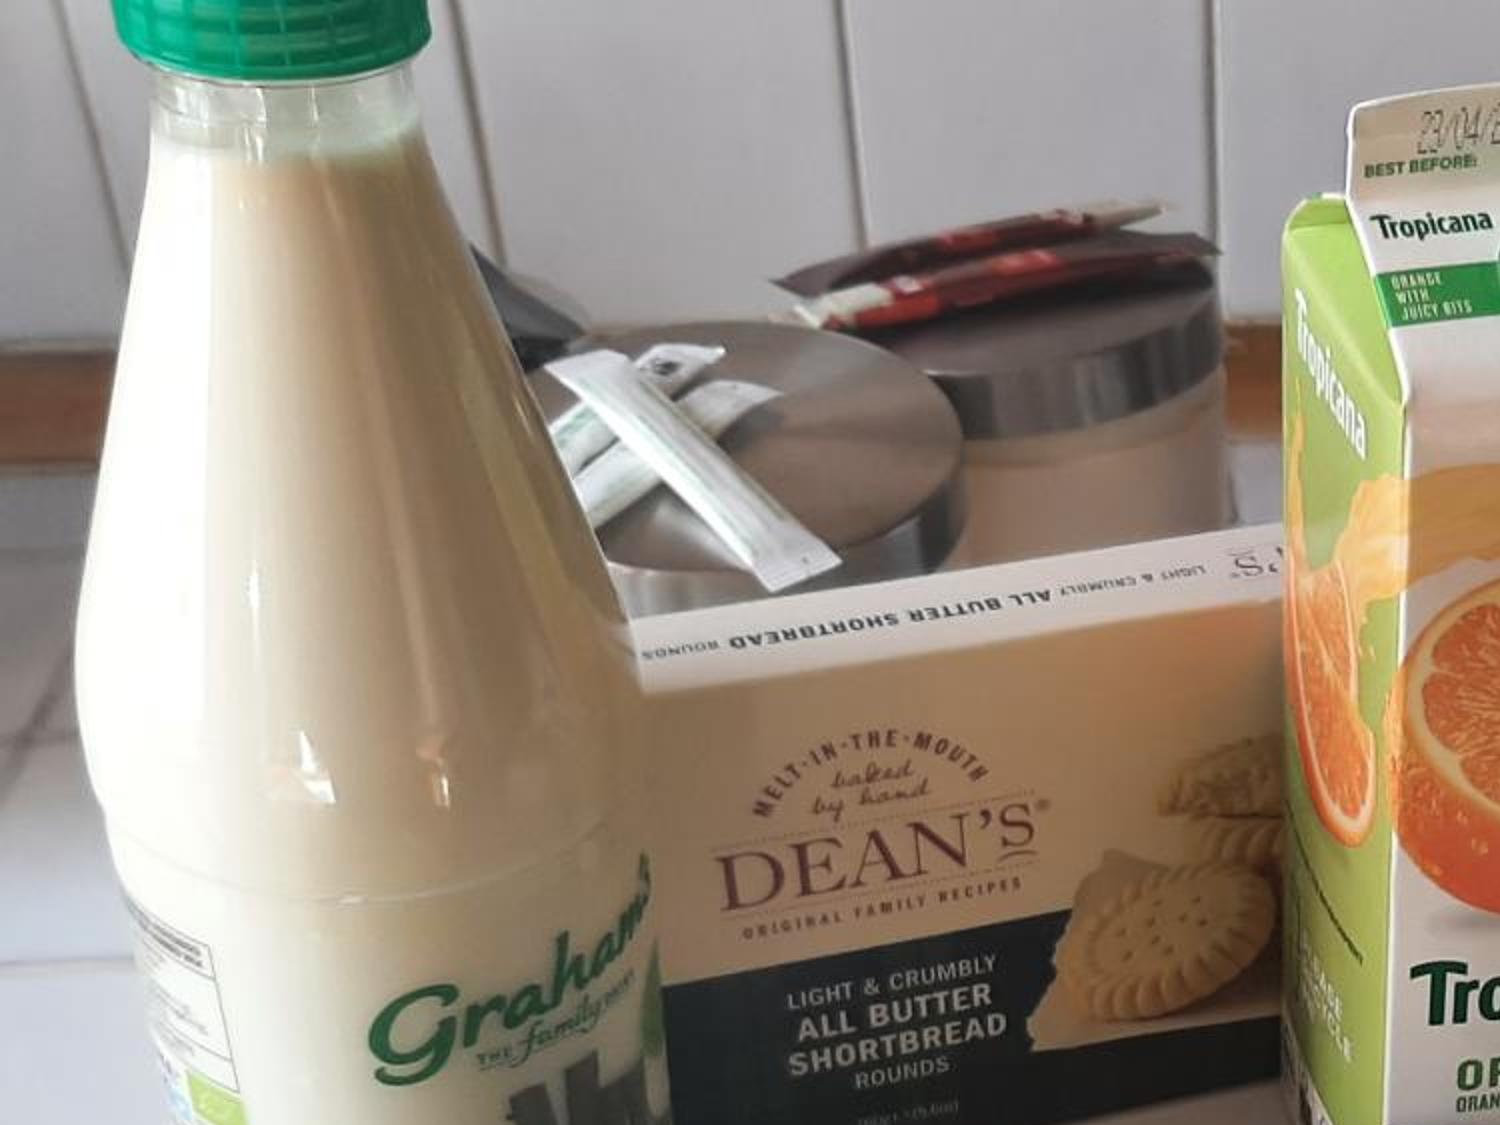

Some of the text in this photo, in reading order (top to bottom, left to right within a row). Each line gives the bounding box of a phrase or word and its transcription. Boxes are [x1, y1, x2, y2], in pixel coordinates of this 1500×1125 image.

[1364, 154, 1478, 178] BEST BEFORE:
[1369, 211, 1494, 241] Tropicana
[1390, 271, 1442, 289] ORANGE
[1396, 288, 1430, 304] WITH
[1401, 299, 1473, 320] JUICY BITS
[1295, 287, 1366, 461] Tropicana
[641, 563, 1208, 662] LIGHT & CRUMBLY ALL BUTTER SHORTBREAD ROUNDS
[811, 798, 845, 827] by
[713, 802, 1037, 912] DEAN'S
[741, 876, 1022, 940] ORIGINAL FAMILY RECIPES
[787, 953, 997, 1010] LIGHT & CRUMBLY
[505, 993, 602, 1068] family
[797, 982, 993, 1041] ALL BUTTER
[787, 1012, 1008, 1077] SHORTBREAD
[854, 1055, 951, 1089] ROUNDS
